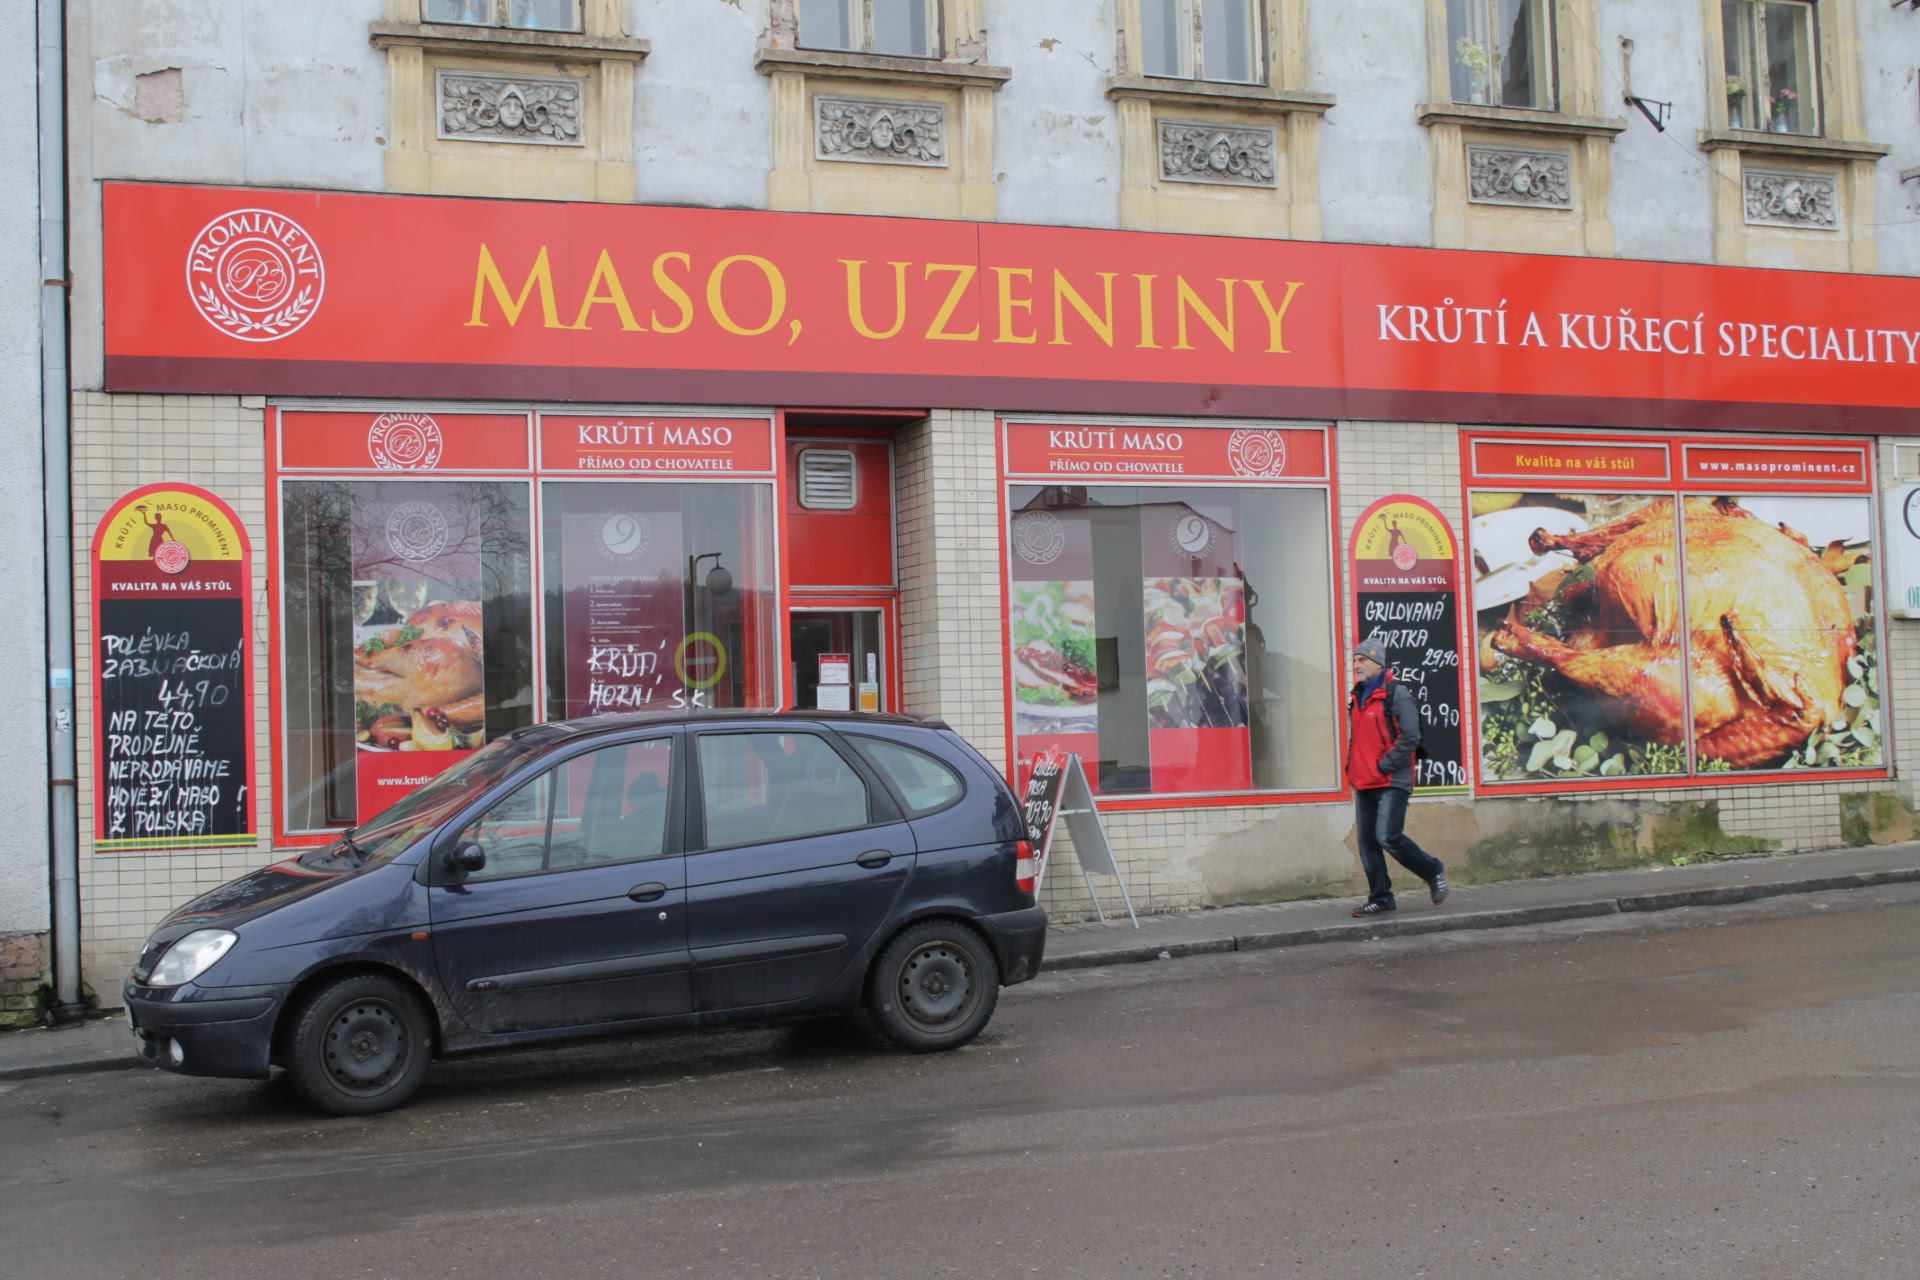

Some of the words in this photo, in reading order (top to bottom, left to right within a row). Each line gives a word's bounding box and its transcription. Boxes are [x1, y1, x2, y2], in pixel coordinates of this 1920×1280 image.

[193, 213, 319, 279] PROMINENT
[463, 242, 803, 346] MASO,
[837, 259, 1305, 354] UZENINY
[1376, 297, 1509, 345] KRŮTÍ
[1519, 315, 1549, 348] A
[1558, 308, 1706, 355] KUŘECÍ
[1718, 322, 1920, 364] SPECIALITY
[578, 421, 655, 445] KRŮTÍ
[663, 427, 733, 446] MASO
[1048, 427, 1115, 449] KRŮTÍ
[1122, 432, 1183, 451] MASO
[578, 455, 625, 469] PŘÍMO
[629, 458, 651, 469] OD
[655, 458, 733, 470] CHOVATELE
[1050, 459, 1090, 472] PŘÍMO
[1093, 461, 1112, 472] OD
[1116, 461, 1184, 473] CHOVATELE
[1516, 454, 1562, 468] Kvalita
[1566, 457, 1581, 468] na
[1586, 457, 1607, 469] váš
[1611, 457, 1635, 470] stůl
[1699, 461, 1856, 474] www.masoprominent.cz
[156, 503, 187, 512] MASO
[189, 507, 230, 557] PROMINENT
[112, 582, 158, 591] KVALITA
[162, 582, 177, 591] NA
[180, 580, 202, 591] VÁŠ
[205, 580, 232, 591] STŮL
[1363, 577, 1396, 585] KVALITA
[1399, 577, 1410, 585] NA
[1411, 576, 1426, 585] VÁŠ
[1428, 576, 1447, 585] STŮL
[1365, 594, 1447, 623] GRILOVANÁ
[102, 626, 189, 655] POLÉVKA
[1422, 648, 1459, 668] 29,90
[109, 710, 137, 731] NA
[145, 708, 194, 731] TÉTO
[1421, 703, 1460, 728] 9,90
[109, 754, 230, 780] NEPRODÁVÁME
[177, 785, 220, 808] MASO
[135, 810, 206, 834] POLSKA
